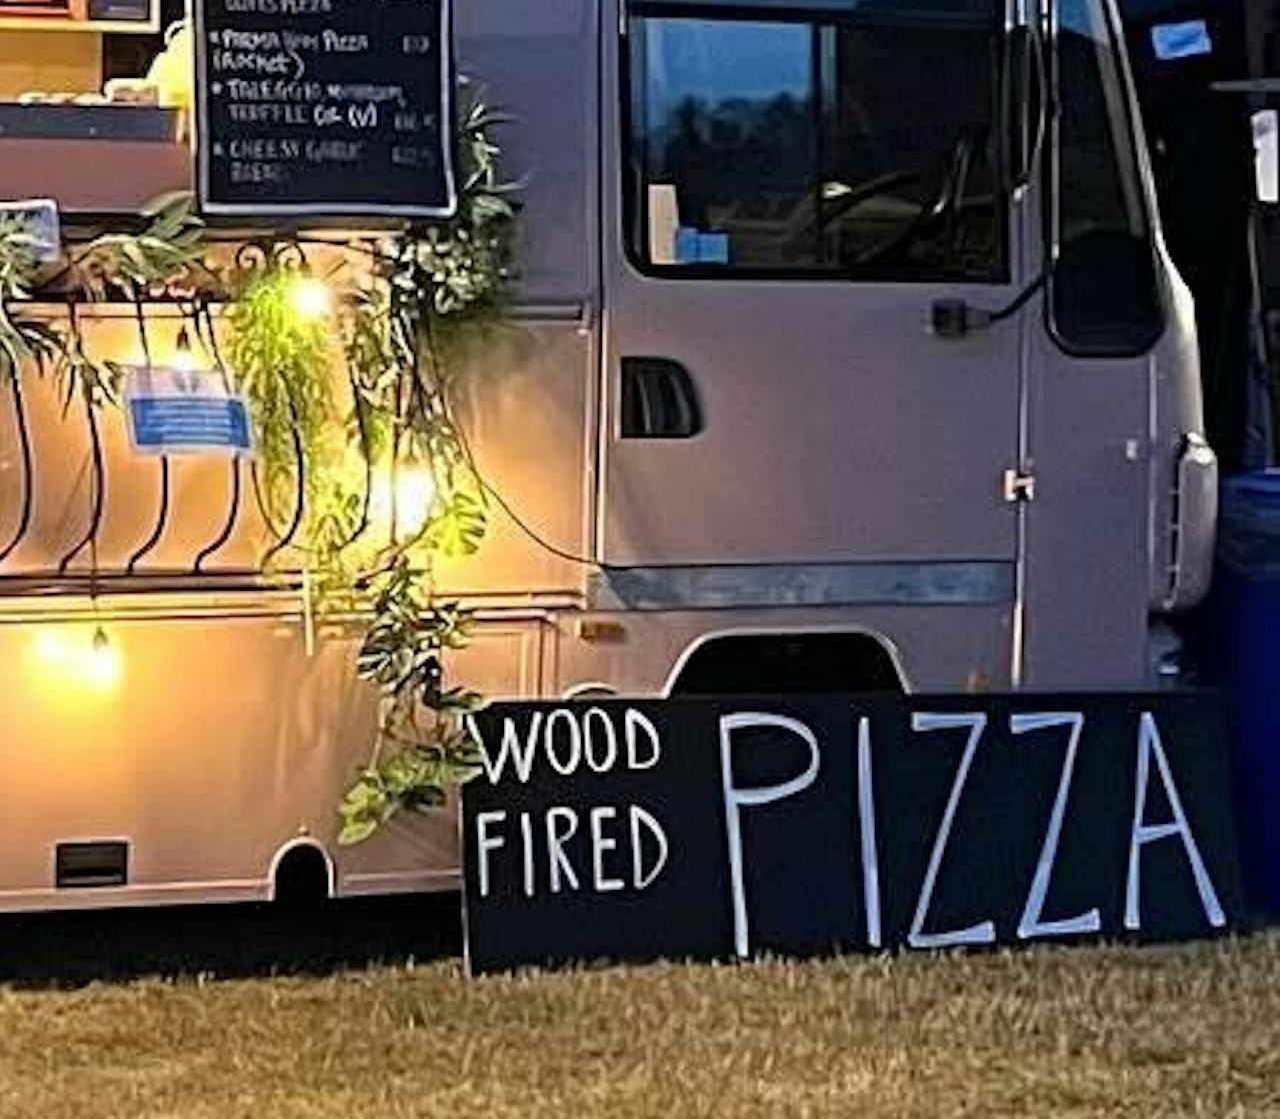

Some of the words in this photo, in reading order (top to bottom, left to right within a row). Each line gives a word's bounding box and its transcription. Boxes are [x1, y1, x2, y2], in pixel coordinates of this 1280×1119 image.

[463, 708, 661, 785] WOOD
[476, 806, 669, 897] FIRED
[720, 711, 1226, 959] PIZZA
